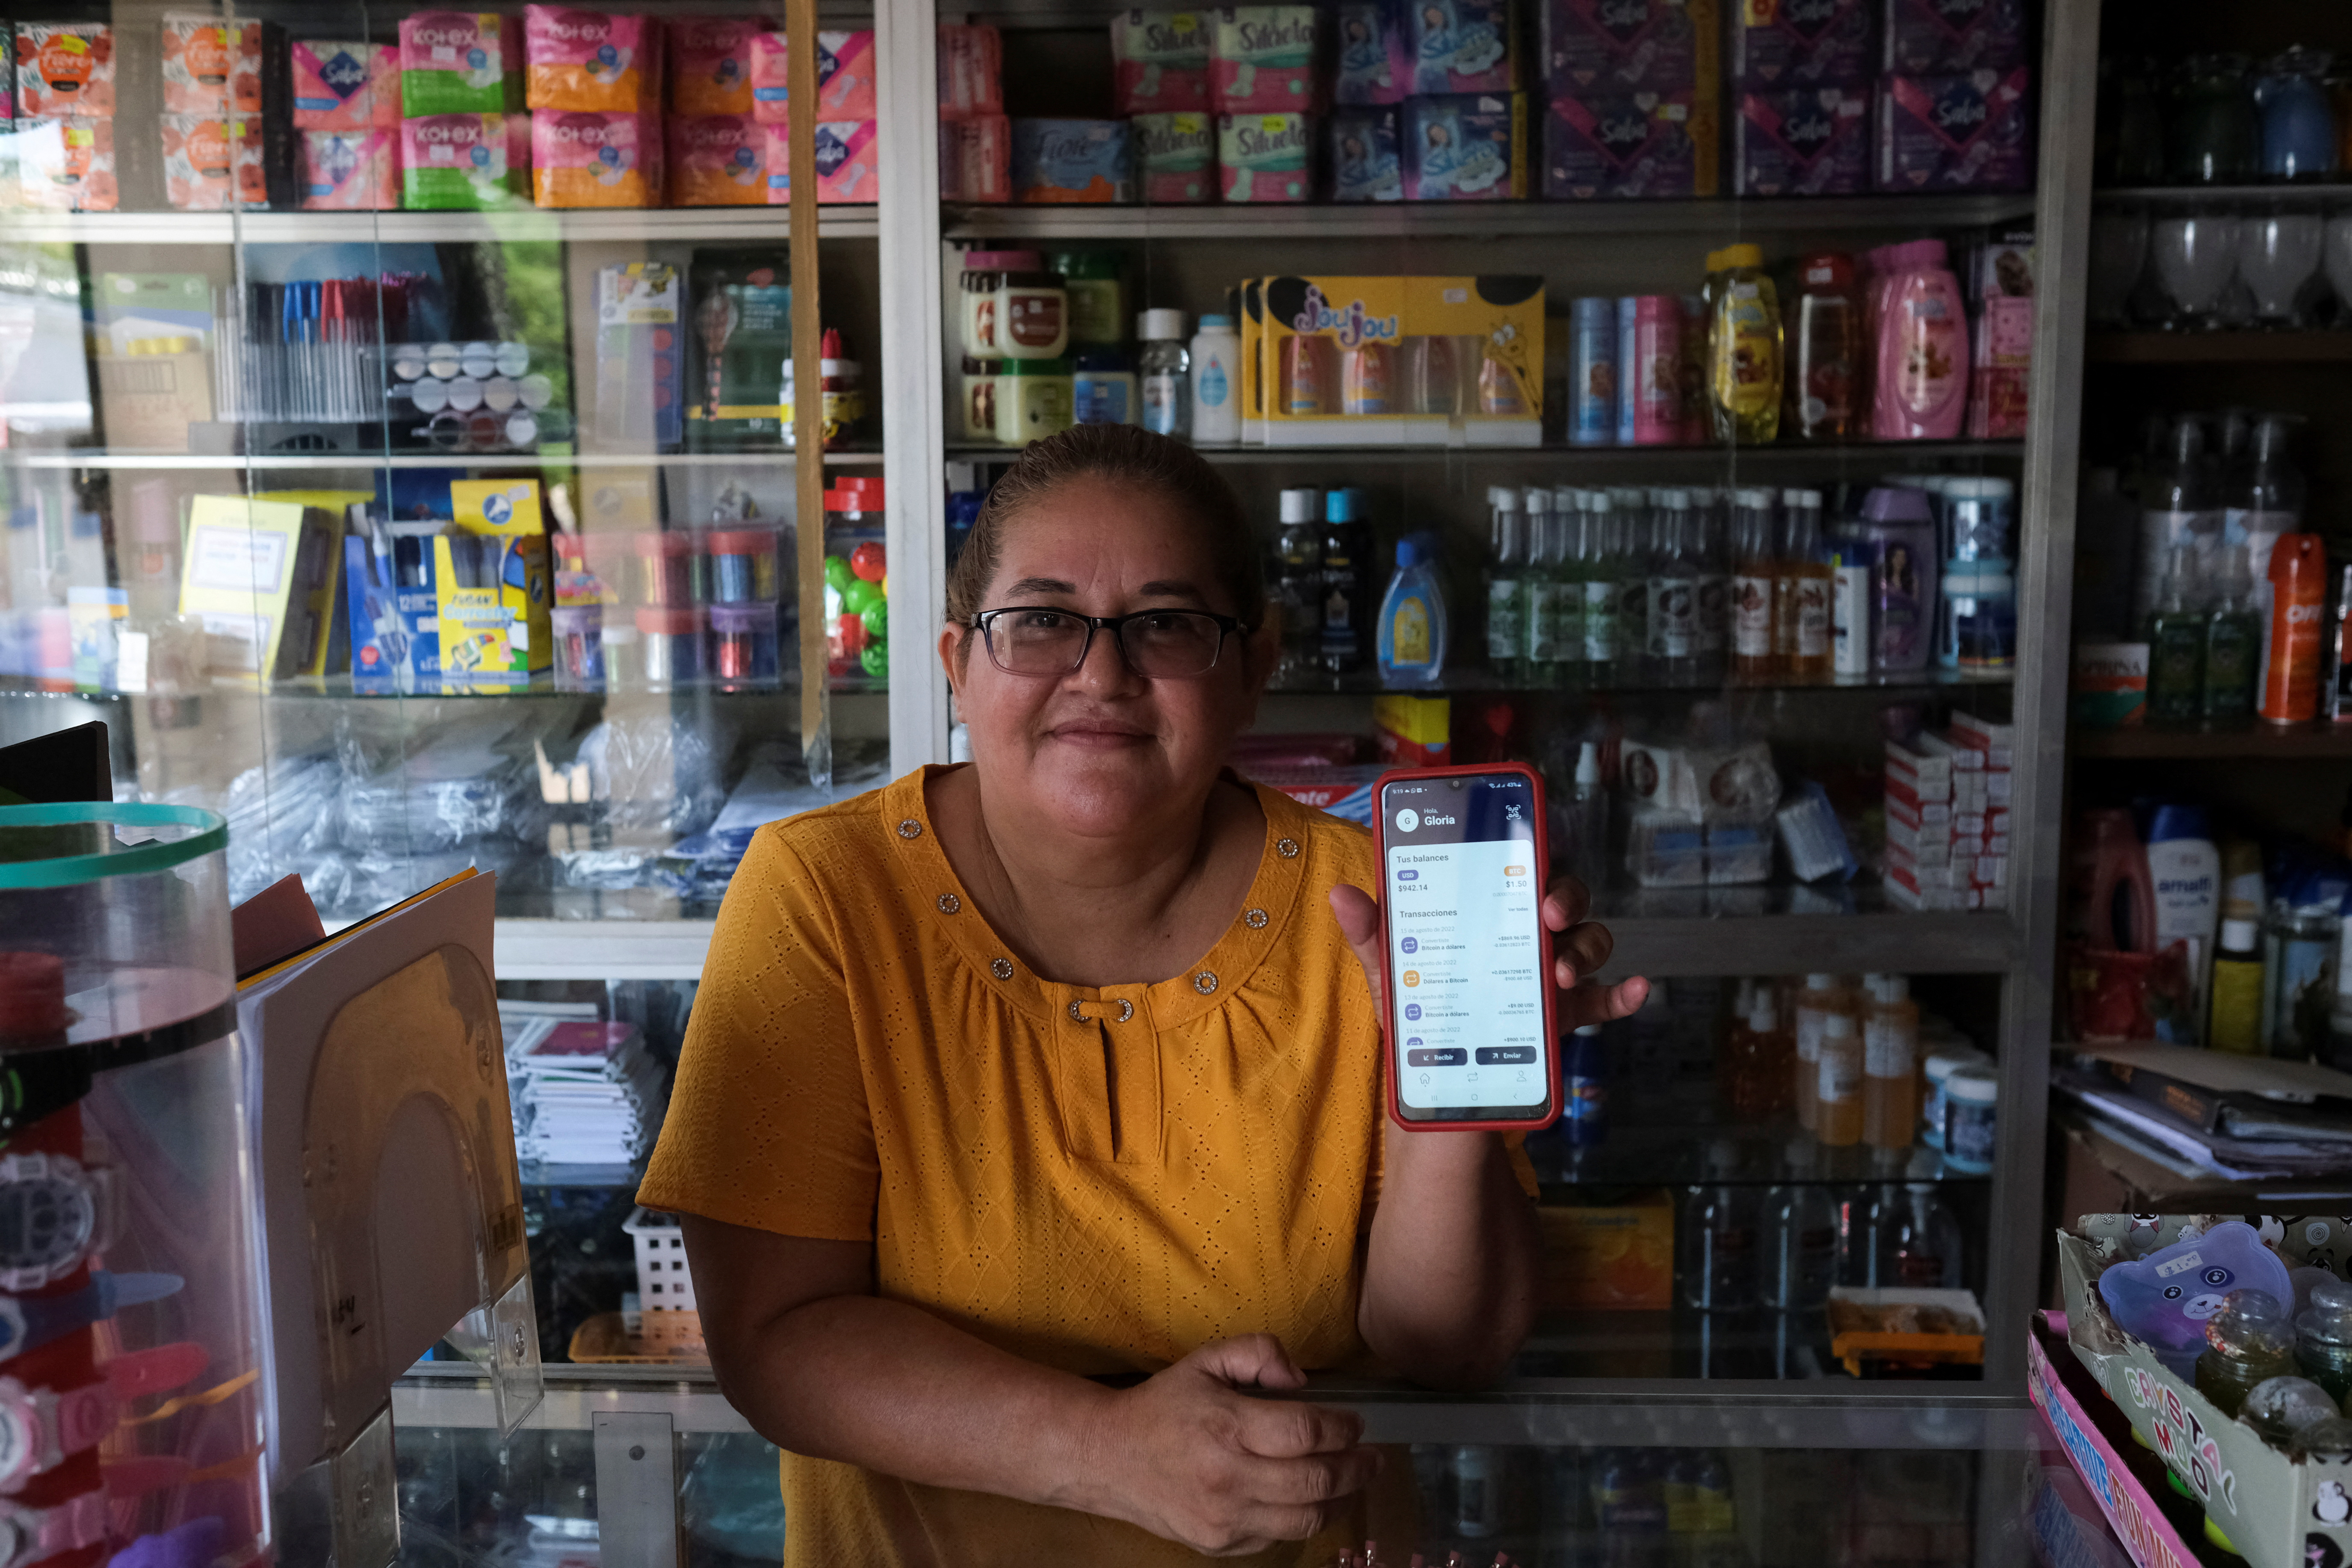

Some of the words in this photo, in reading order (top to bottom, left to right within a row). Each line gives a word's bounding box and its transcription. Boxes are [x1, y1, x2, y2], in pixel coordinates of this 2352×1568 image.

[815, 139, 845, 163] aba
[1424, 815, 1455, 826] Gloria
[1400, 909, 1457, 918] Transacciones
[2110, 1468, 2148, 1563] FUN
